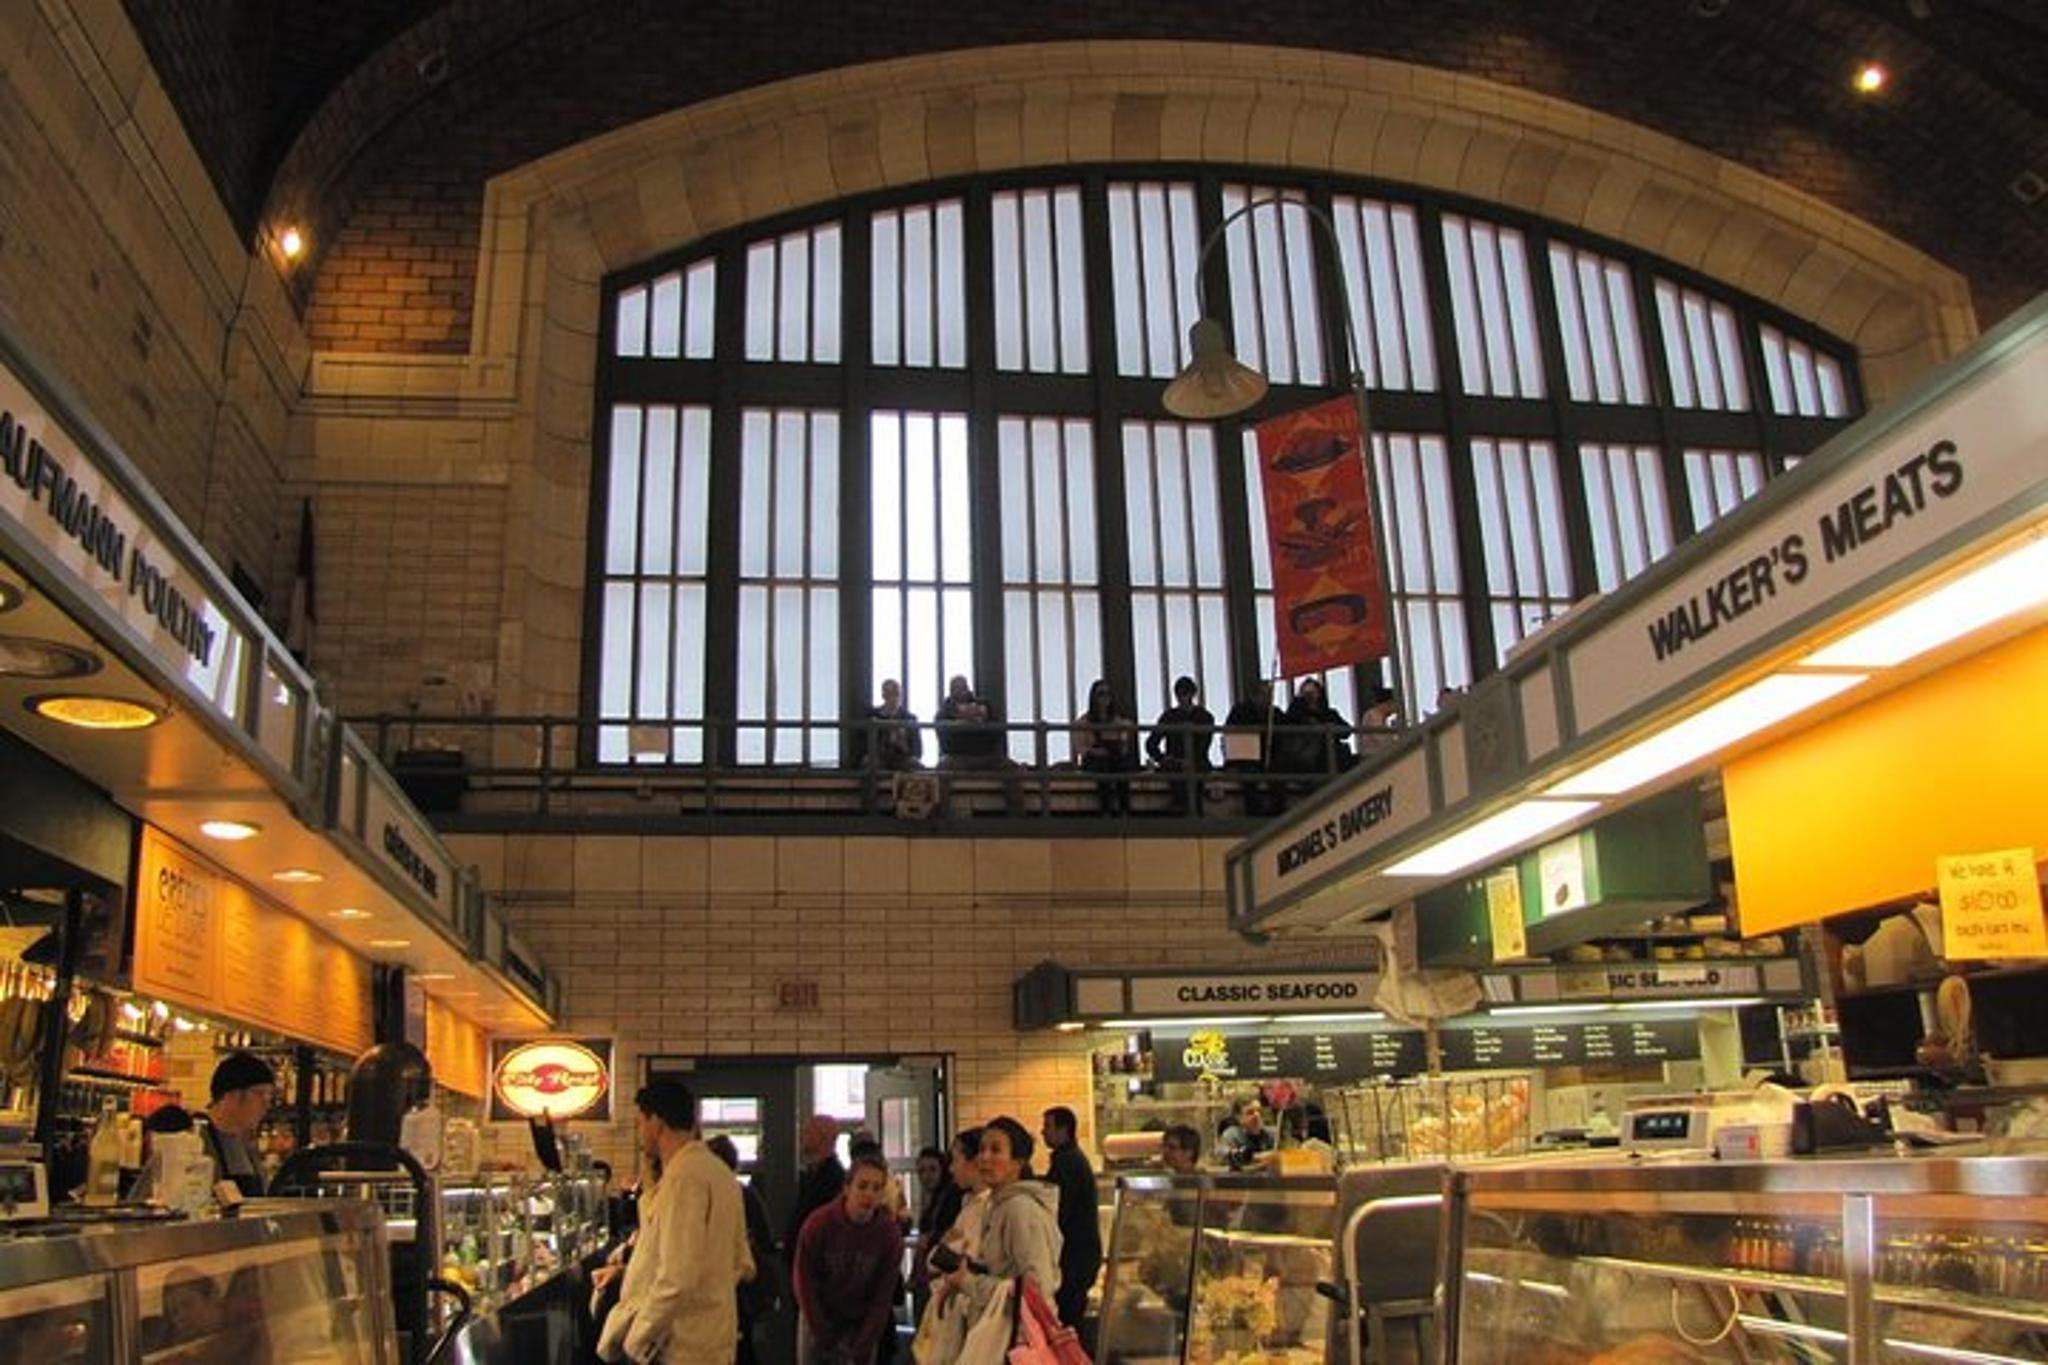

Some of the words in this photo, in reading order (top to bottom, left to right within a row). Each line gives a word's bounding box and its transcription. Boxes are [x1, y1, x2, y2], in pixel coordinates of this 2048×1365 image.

[1648, 535, 1809, 661] WALKER'S
[1819, 440, 1964, 563] MEATS
[1338, 784, 1393, 842] BAKERY
[1177, 984, 1262, 1002] CLASSIC
[1266, 982, 1359, 1000] SEAFOOD
